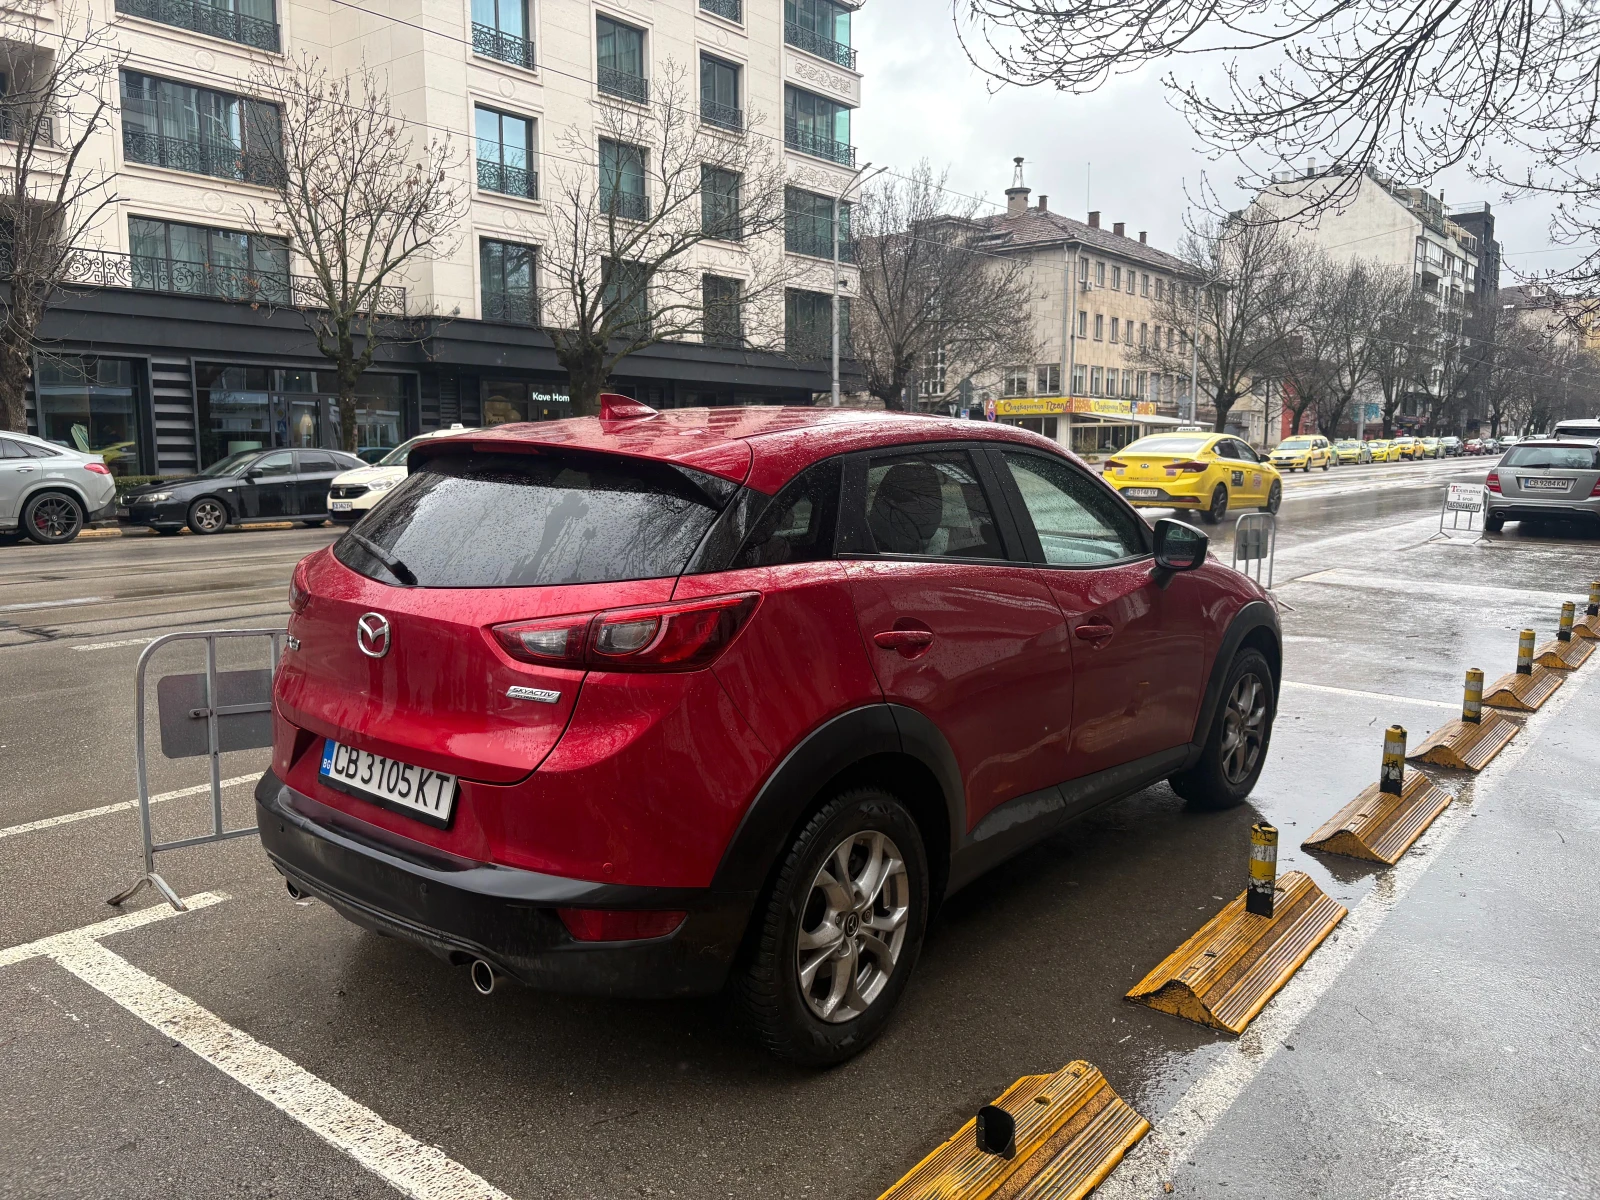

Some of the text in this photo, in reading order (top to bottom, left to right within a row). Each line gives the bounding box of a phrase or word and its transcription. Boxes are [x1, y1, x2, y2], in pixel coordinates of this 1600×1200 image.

[532, 392, 570, 402] Kave Hom
[511, 687, 555, 697] SKYACTIV
[322, 758, 332, 770] BG
